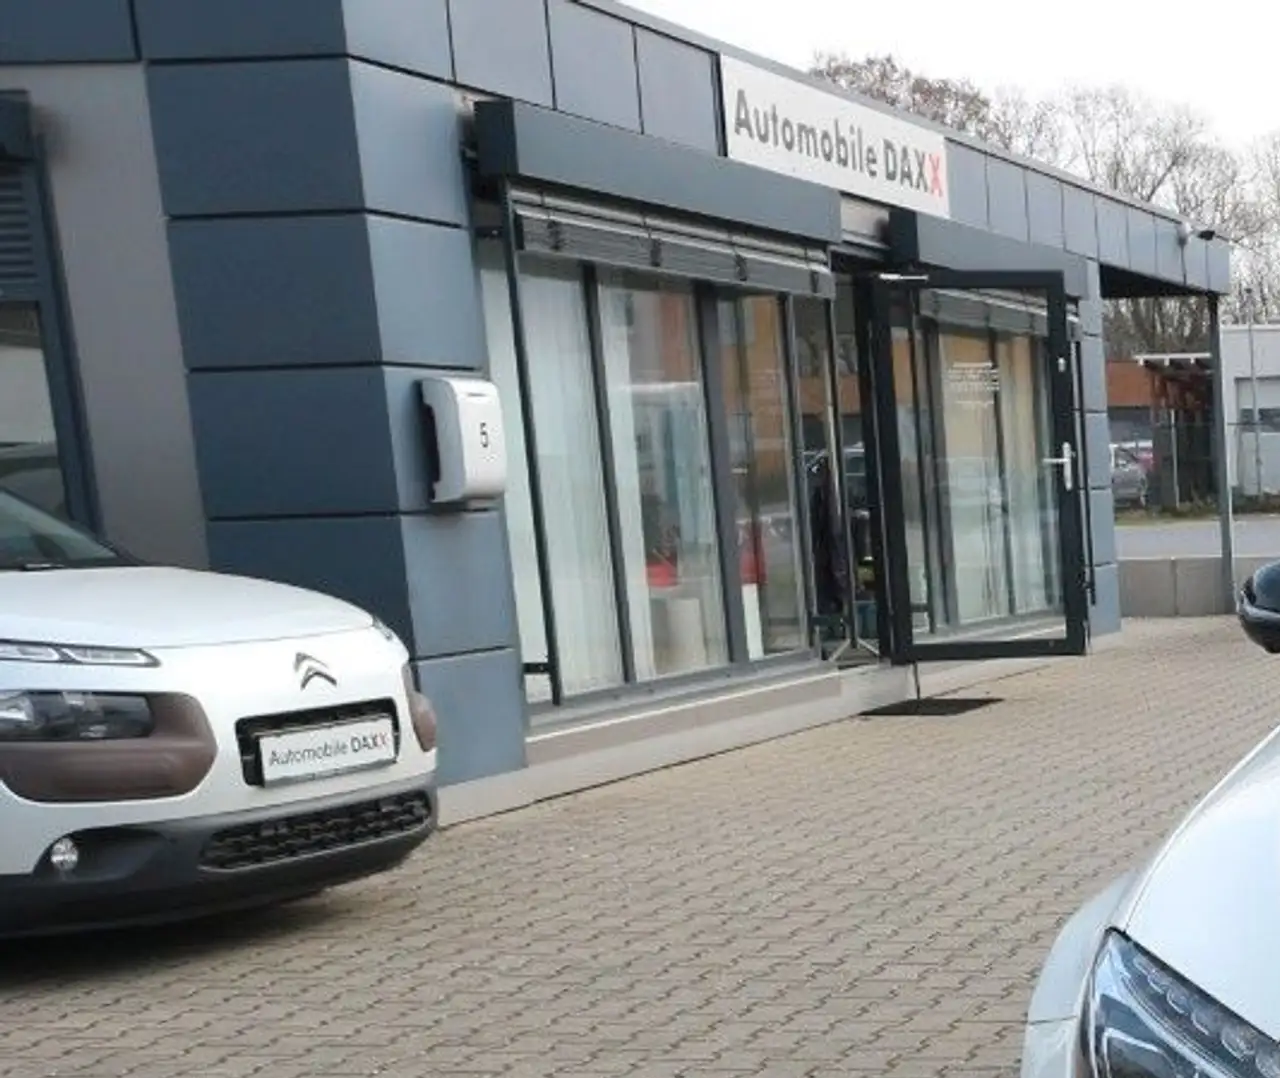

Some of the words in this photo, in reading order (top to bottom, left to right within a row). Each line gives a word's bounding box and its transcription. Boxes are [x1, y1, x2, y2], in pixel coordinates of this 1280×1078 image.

[734, 88, 878, 177] Automobile
[883, 137, 943, 197] DAXX
[479, 422, 489, 448] 5
[269, 740, 348, 767] Automobile
